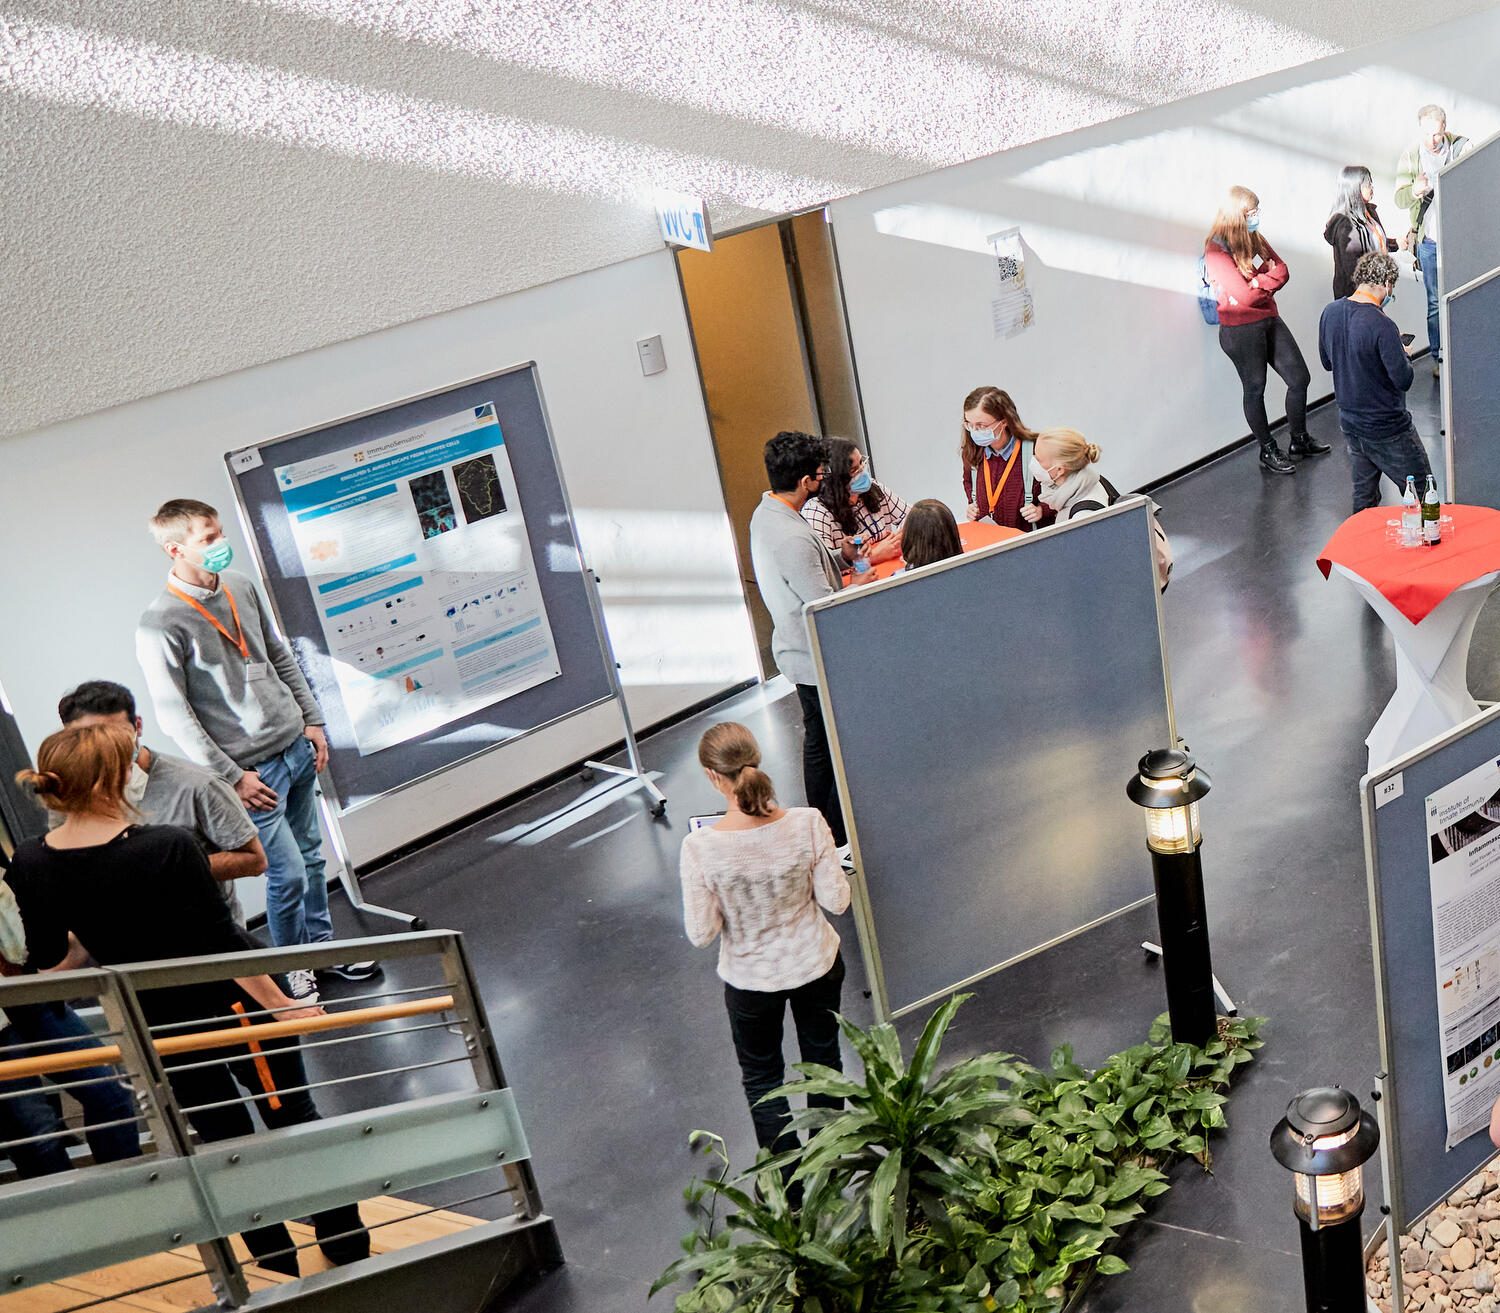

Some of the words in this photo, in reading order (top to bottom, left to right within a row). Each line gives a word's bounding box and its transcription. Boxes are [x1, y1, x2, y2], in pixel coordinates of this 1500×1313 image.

[663, 207, 692, 241] WC
[241, 455, 253, 464] #13
[1383, 784, 1395, 794] #32
[1463, 796, 1470, 807] of
